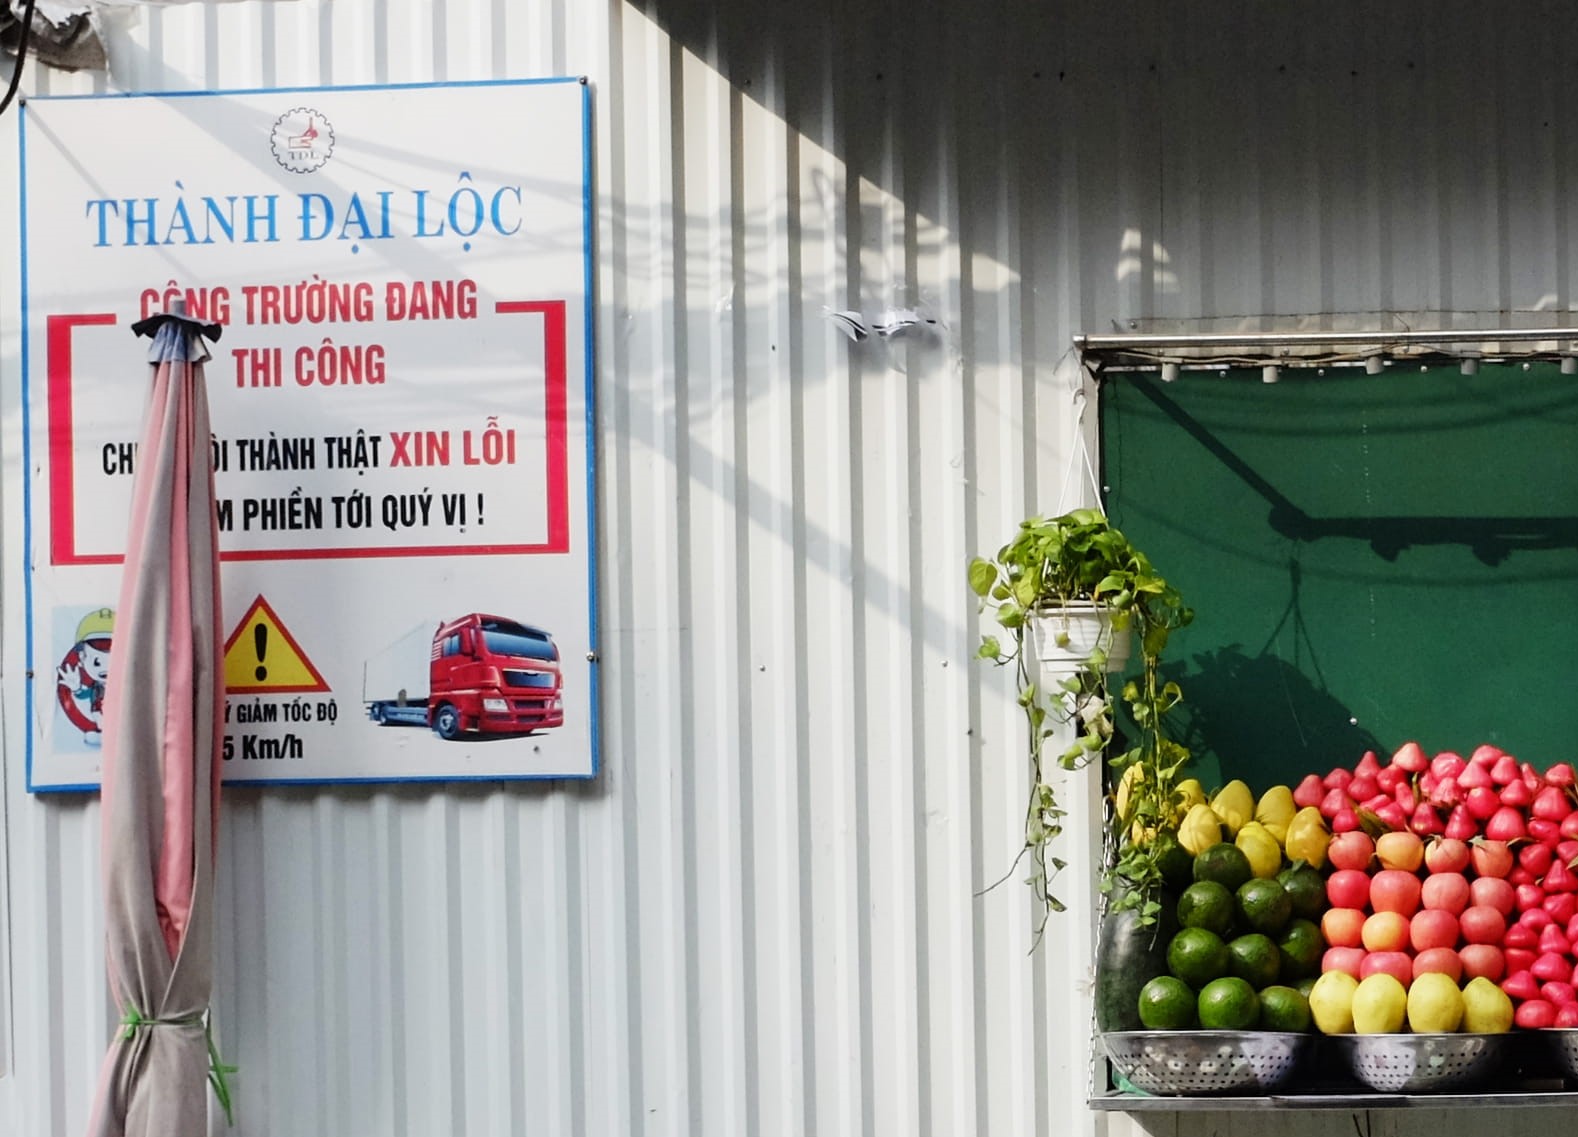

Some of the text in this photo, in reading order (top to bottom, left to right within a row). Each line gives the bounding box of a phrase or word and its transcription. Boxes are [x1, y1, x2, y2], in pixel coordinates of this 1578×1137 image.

[86, 171, 523, 254] THÀNH ĐẠI LỘC
[242, 274, 373, 325] TRƯỜNG
[386, 279, 477, 321] ĐANG
[232, 338, 385, 387] THI CÔNG
[236, 431, 315, 471] THÀNH
[321, 429, 381, 477] THẬT
[390, 432, 450, 468] XIN
[463, 417, 516, 466] LỖI
[243, 486, 322, 531] PHIỀN
[331, 487, 372, 531] TỚI
[382, 491, 432, 530] QUÝ
[443, 496, 466, 534] VỊ
[237, 697, 277, 723] GIẢM
[283, 696, 311, 722] TỐC
[317, 699, 337, 725] ĐỘ
[242, 733, 303, 760] Km/h
